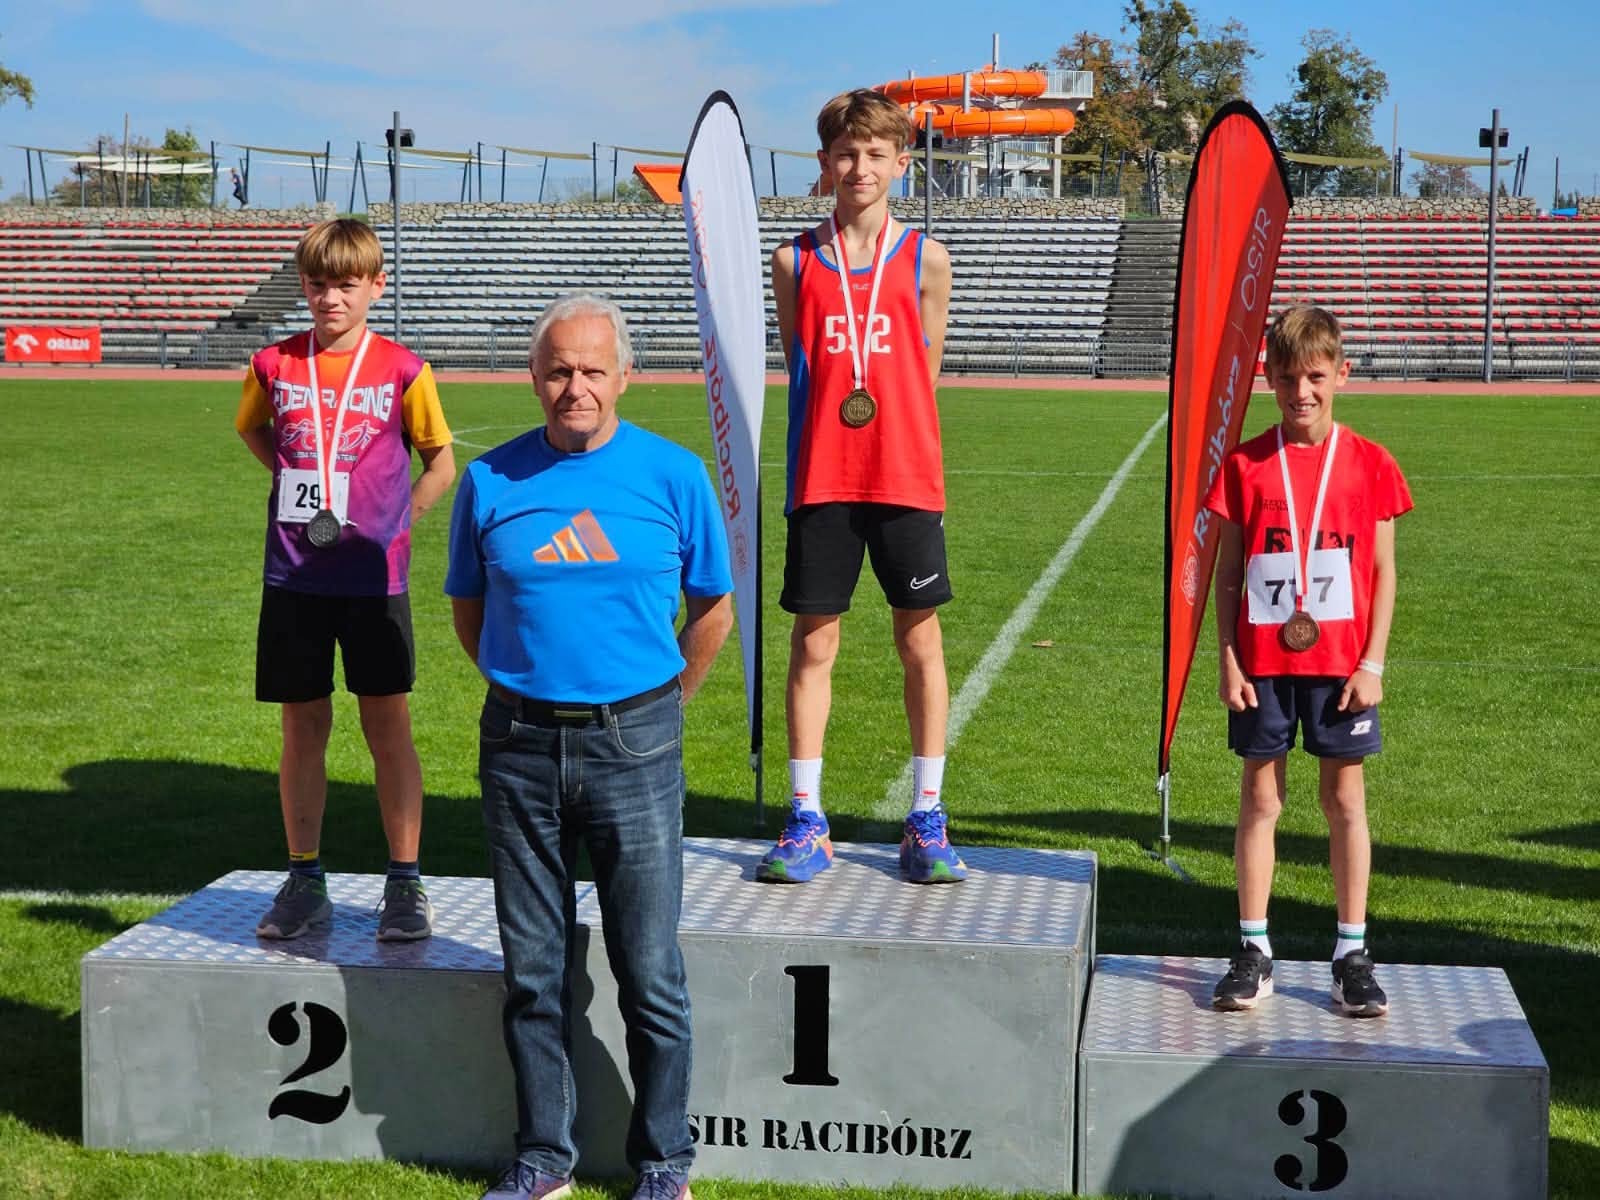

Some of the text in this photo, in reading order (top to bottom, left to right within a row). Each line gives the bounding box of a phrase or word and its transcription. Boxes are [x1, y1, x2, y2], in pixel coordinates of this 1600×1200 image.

[1241, 207, 1271, 312] OSiR
[47, 338, 90, 351] ORLEN
[825, 314, 891, 354] 52
[319, 383, 394, 422] RCING
[295, 482, 321, 509] 29
[782, 964, 839, 1086] 1
[267, 1001, 351, 1124] 2
[762, 1108, 972, 1160] RACIBÓRZ
[1274, 1089, 1348, 1192] 3
